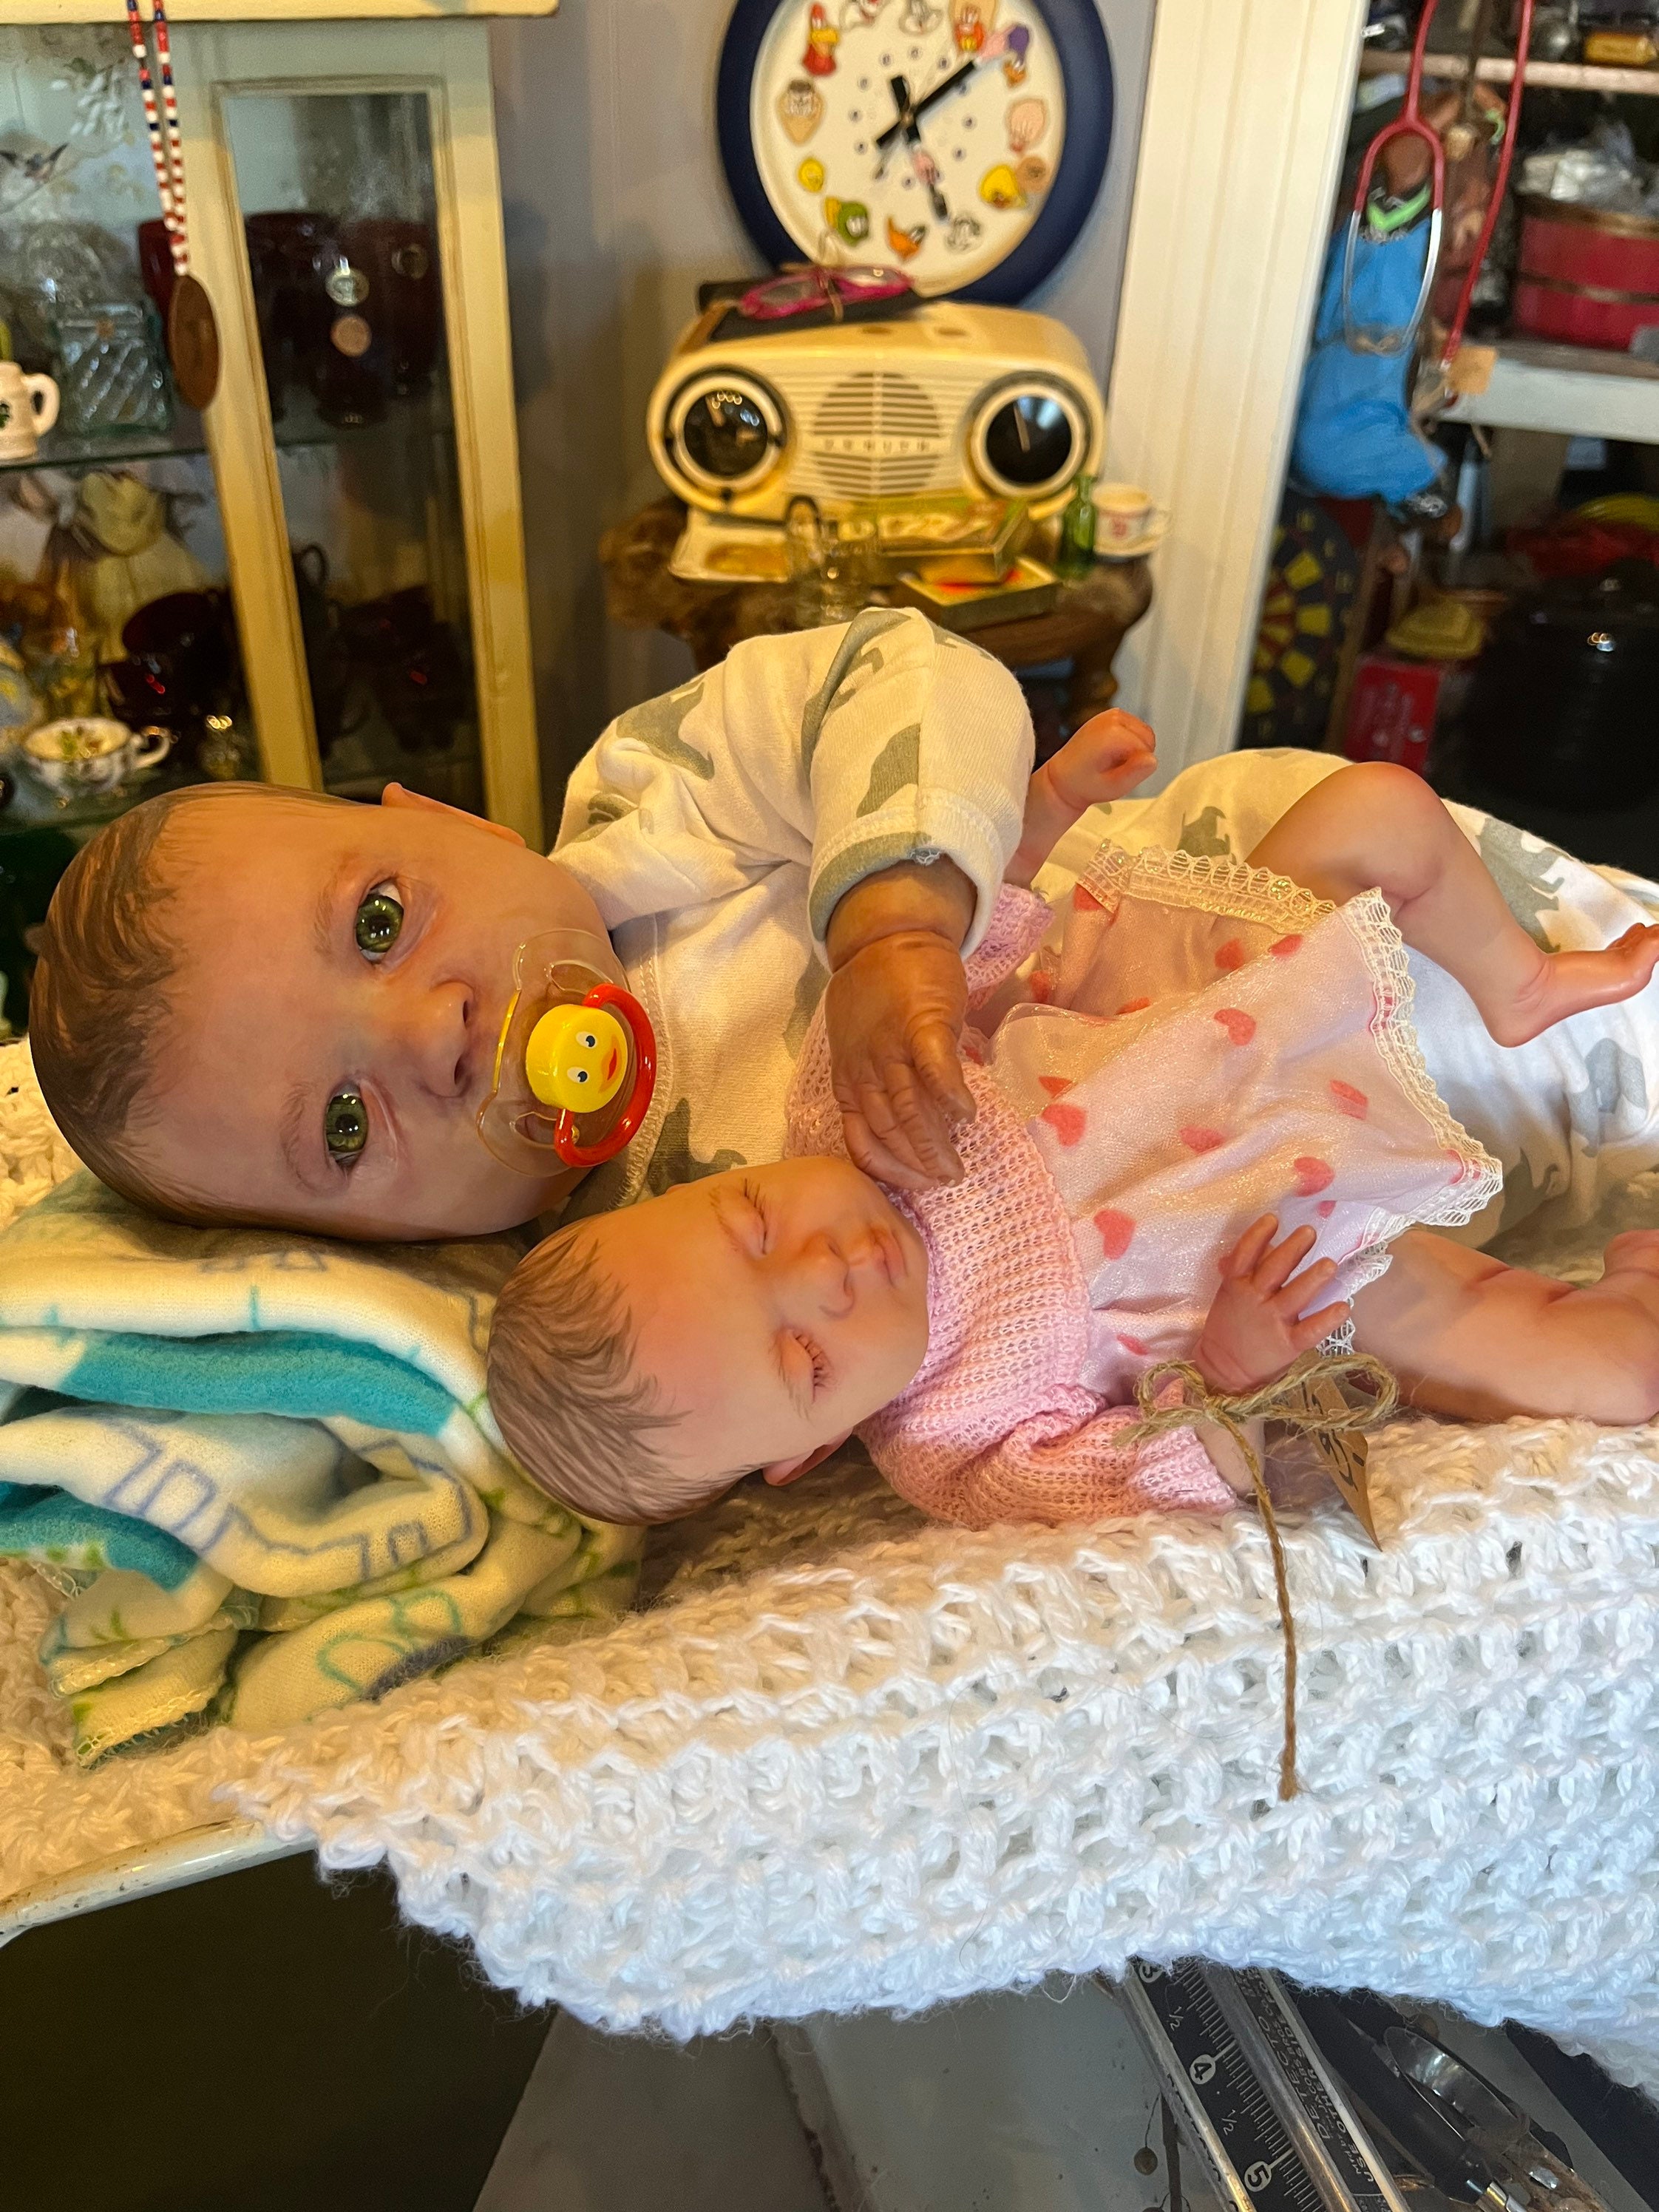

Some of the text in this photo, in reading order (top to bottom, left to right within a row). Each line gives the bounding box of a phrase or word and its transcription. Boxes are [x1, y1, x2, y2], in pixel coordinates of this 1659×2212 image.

[1276, 2013, 1305, 2057] SIDE
[1258, 2016, 1331, 2138] DETECTO
[1293, 2058, 1328, 2112] JACOBS
[1307, 2068, 1346, 2132] OTHER
[1192, 2061, 1212, 2080] 4
[1221, 2108, 1238, 2135] 1/2
[1247, 2167, 1269, 2186] 5
[1348, 2143, 1374, 2181] USE
